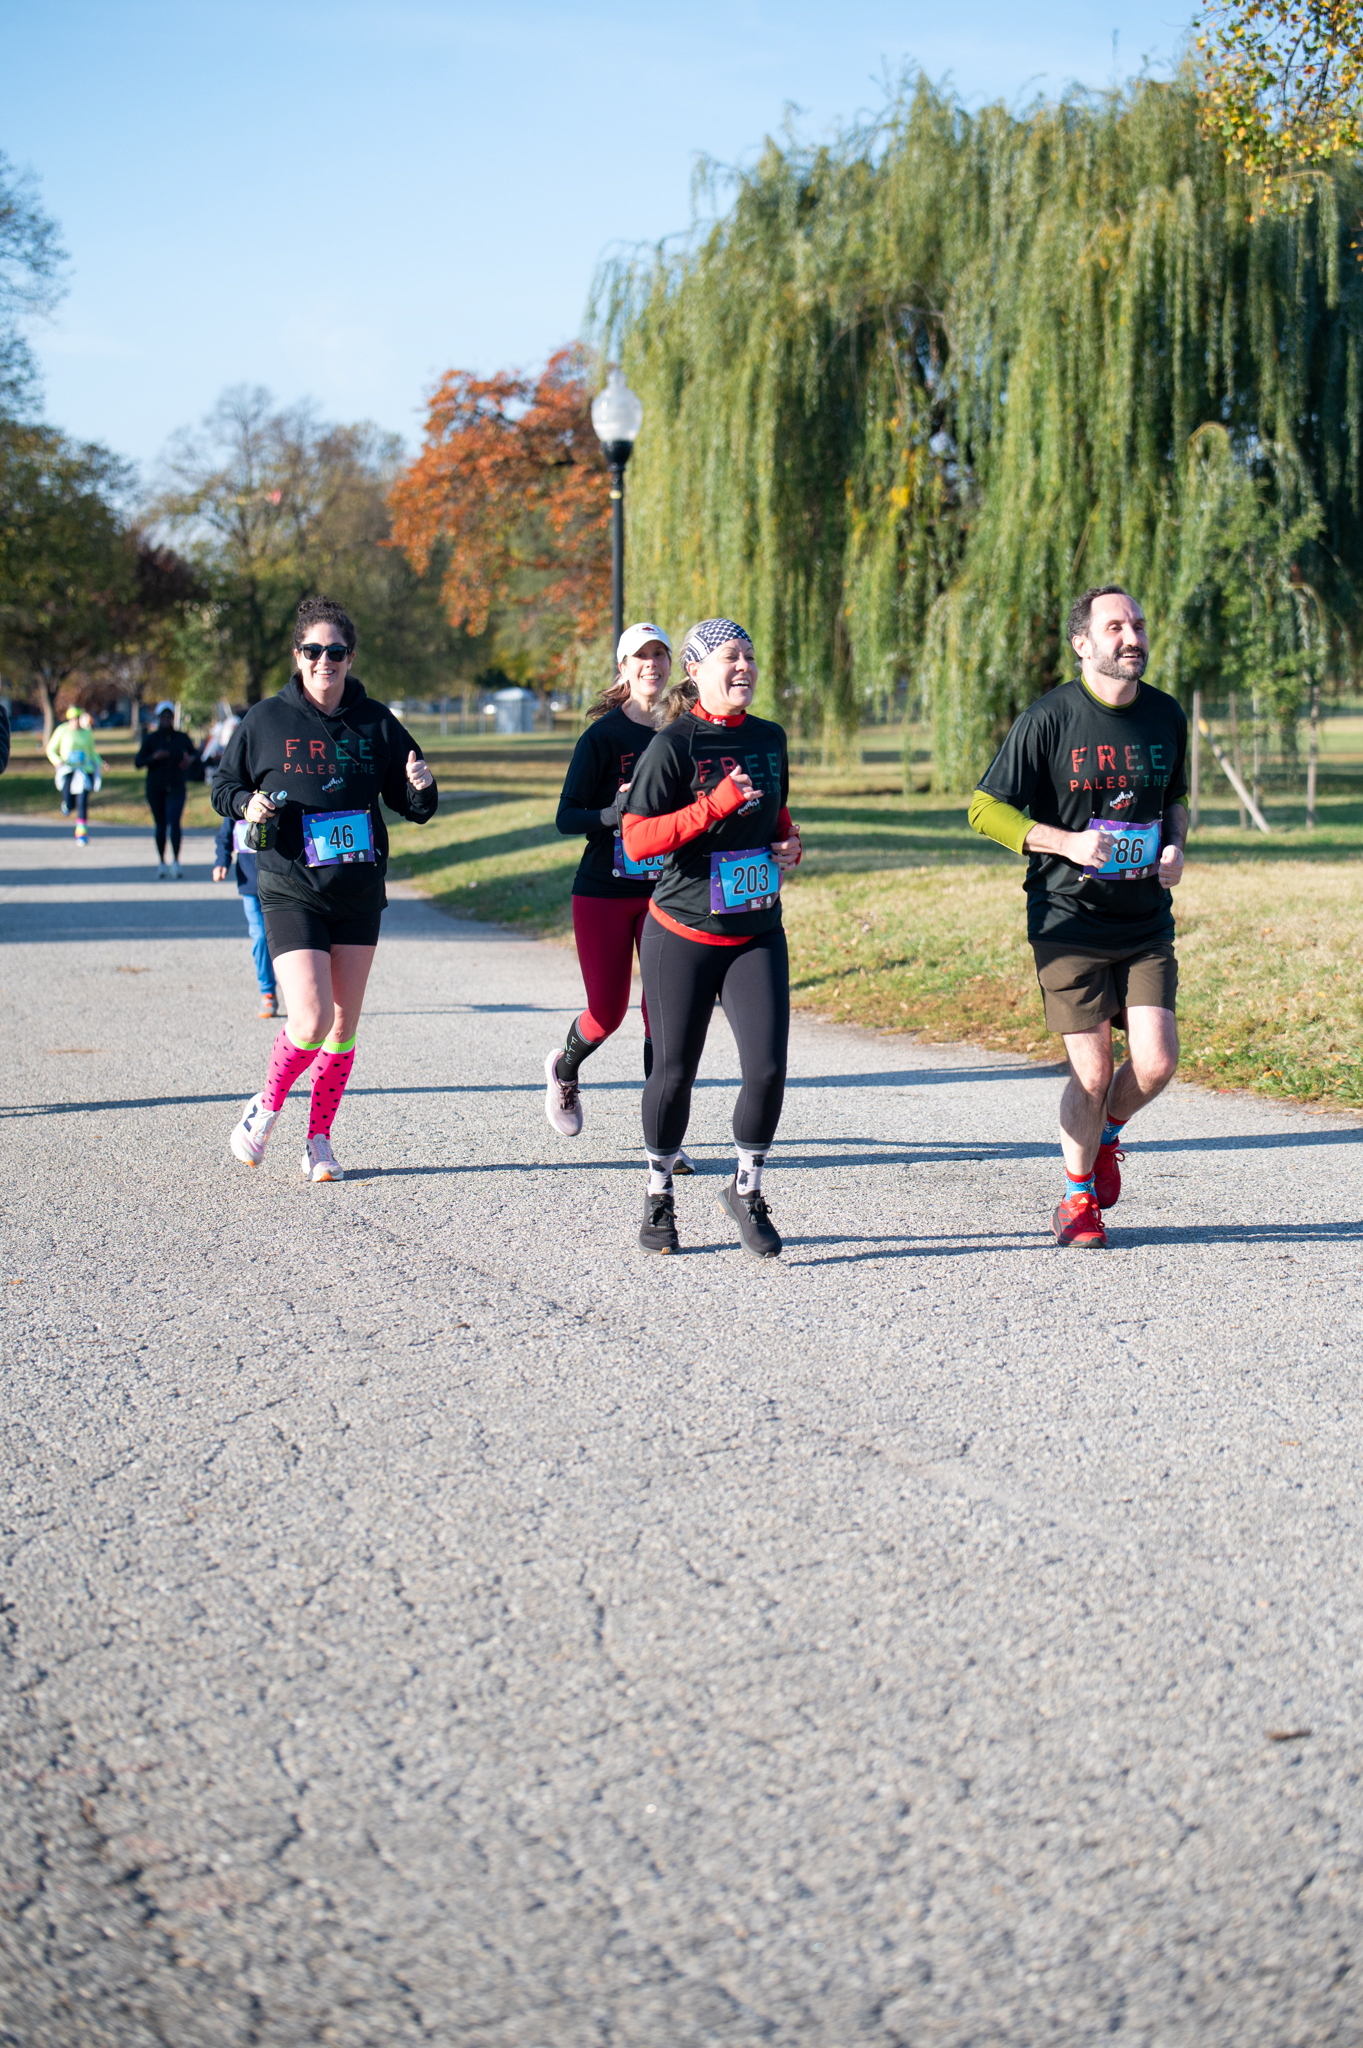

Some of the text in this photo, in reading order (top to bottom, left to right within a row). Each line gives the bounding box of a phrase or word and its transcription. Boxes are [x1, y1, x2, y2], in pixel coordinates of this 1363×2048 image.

[285, 738, 373, 760] FREE
[1071, 744, 1167, 773] FREE
[283, 762, 375, 775] PALESTINE
[697, 752, 780, 784] FREE
[1069, 774, 1169, 792] PALESTINE
[259, 823, 267, 848] HAN
[329, 824, 355, 850] 46
[1115, 838, 1144, 864] 86
[733, 863, 770, 895] 203
